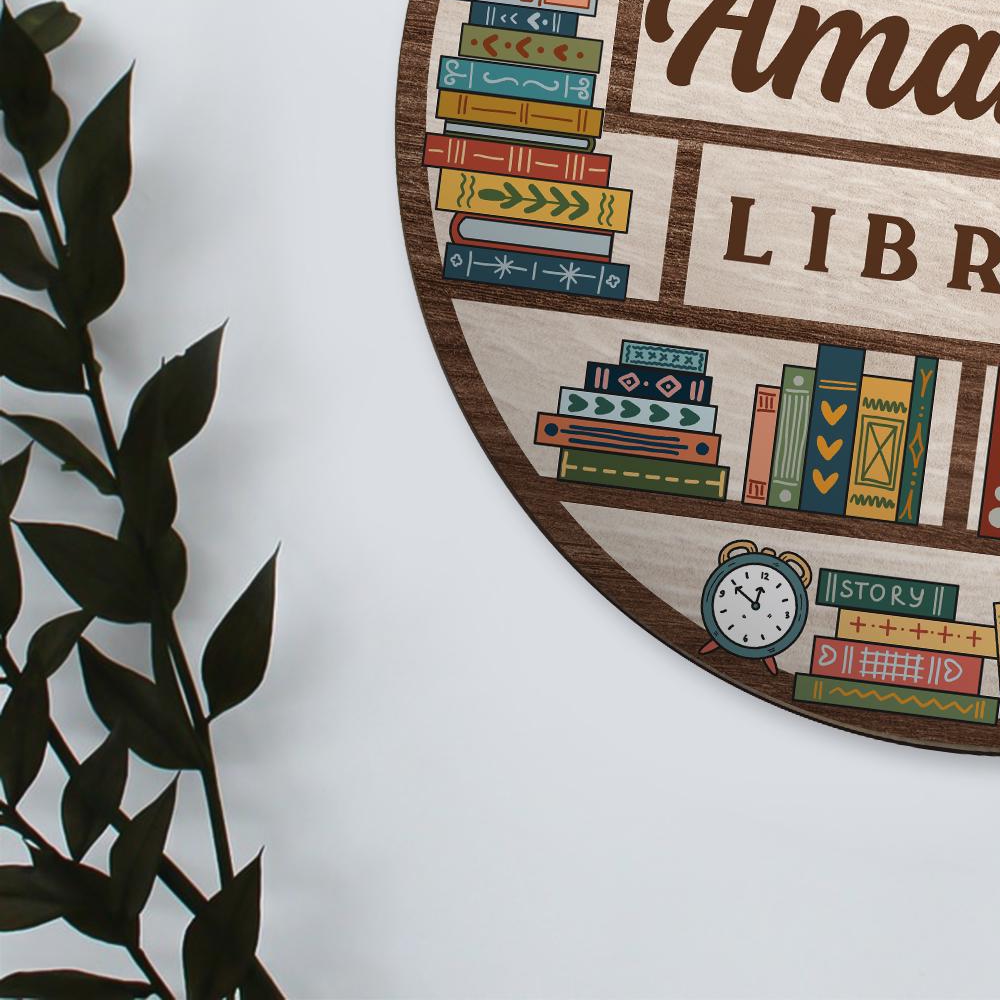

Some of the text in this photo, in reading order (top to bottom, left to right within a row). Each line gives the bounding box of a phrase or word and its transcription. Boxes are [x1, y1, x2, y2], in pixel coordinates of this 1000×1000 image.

[760, 571, 770, 581] 12
[718, 589, 726, 598] 9
[839, 579, 925, 608] STORY
[784, 610, 791, 620] 3
[742, 634, 749, 644] 6
